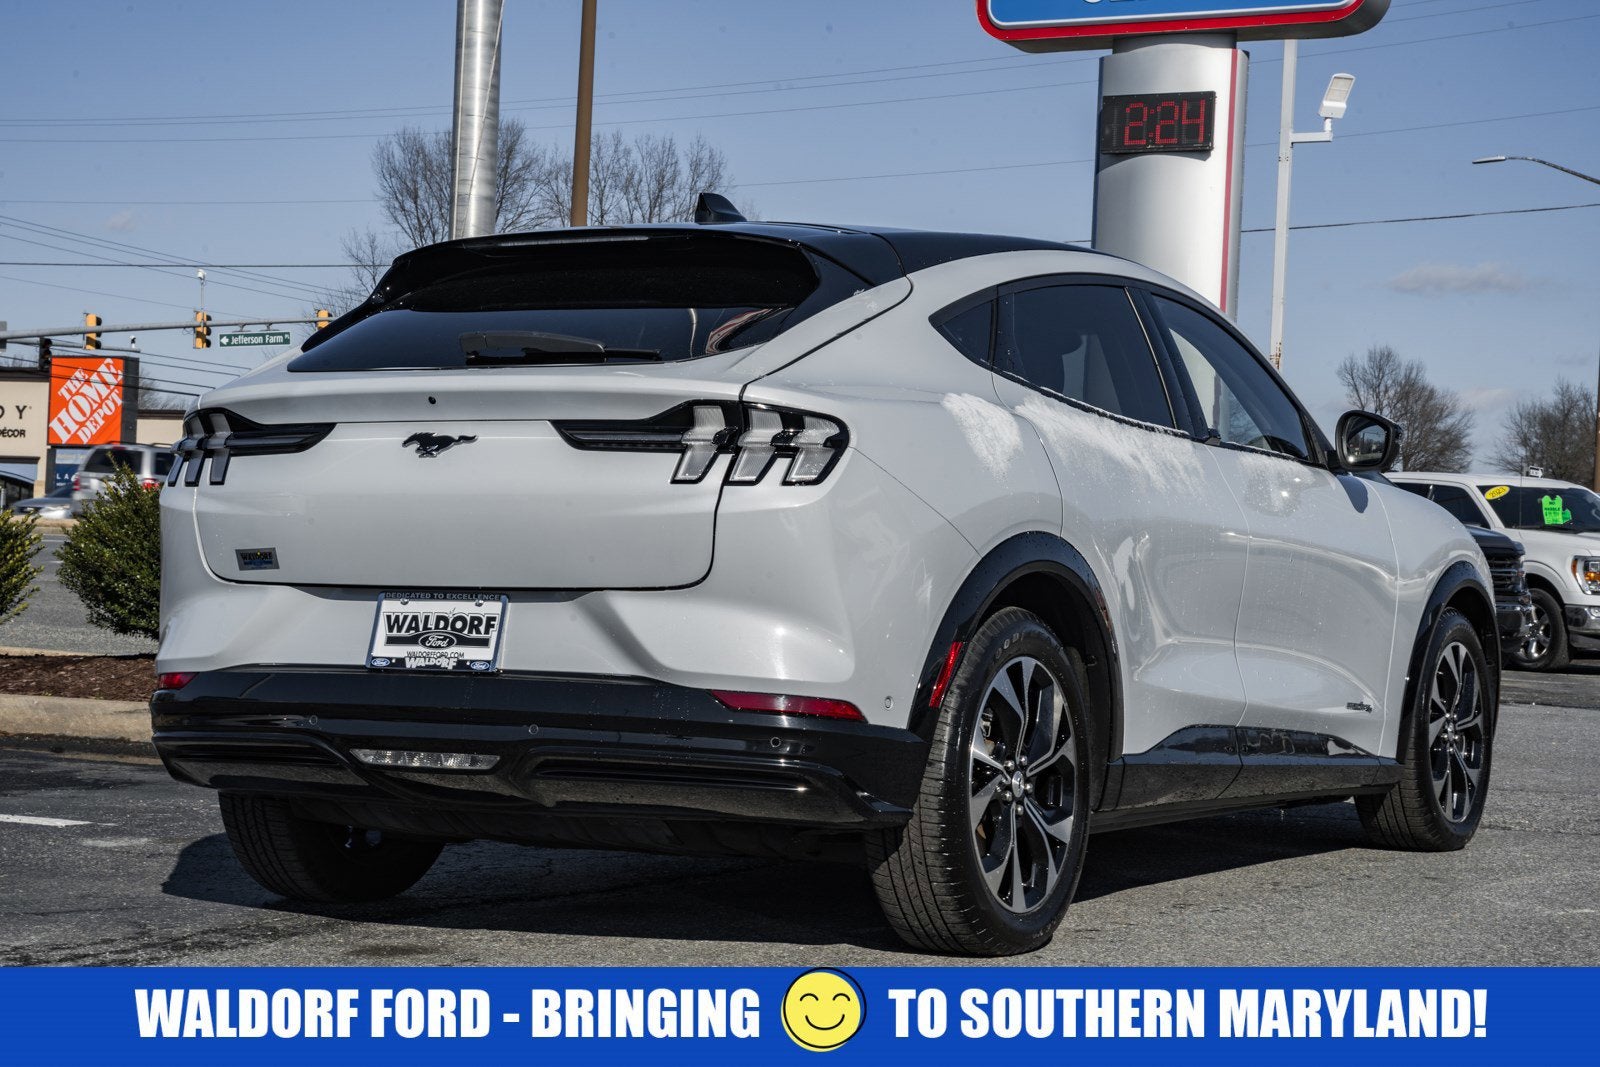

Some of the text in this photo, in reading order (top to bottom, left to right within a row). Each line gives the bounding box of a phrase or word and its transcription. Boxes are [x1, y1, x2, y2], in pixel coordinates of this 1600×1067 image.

[1123, 99, 1205, 146] 2:24
[231, 334, 263, 345] Jefferson
[265, 334, 283, 344] Farm
[58, 368, 89, 401] THE
[49, 358, 124, 445] HOME
[76, 389, 123, 445] DEPOT
[385, 614, 498, 635] WALDORF
[425, 635, 450, 648] Ford
[404, 656, 458, 669] WALDORF
